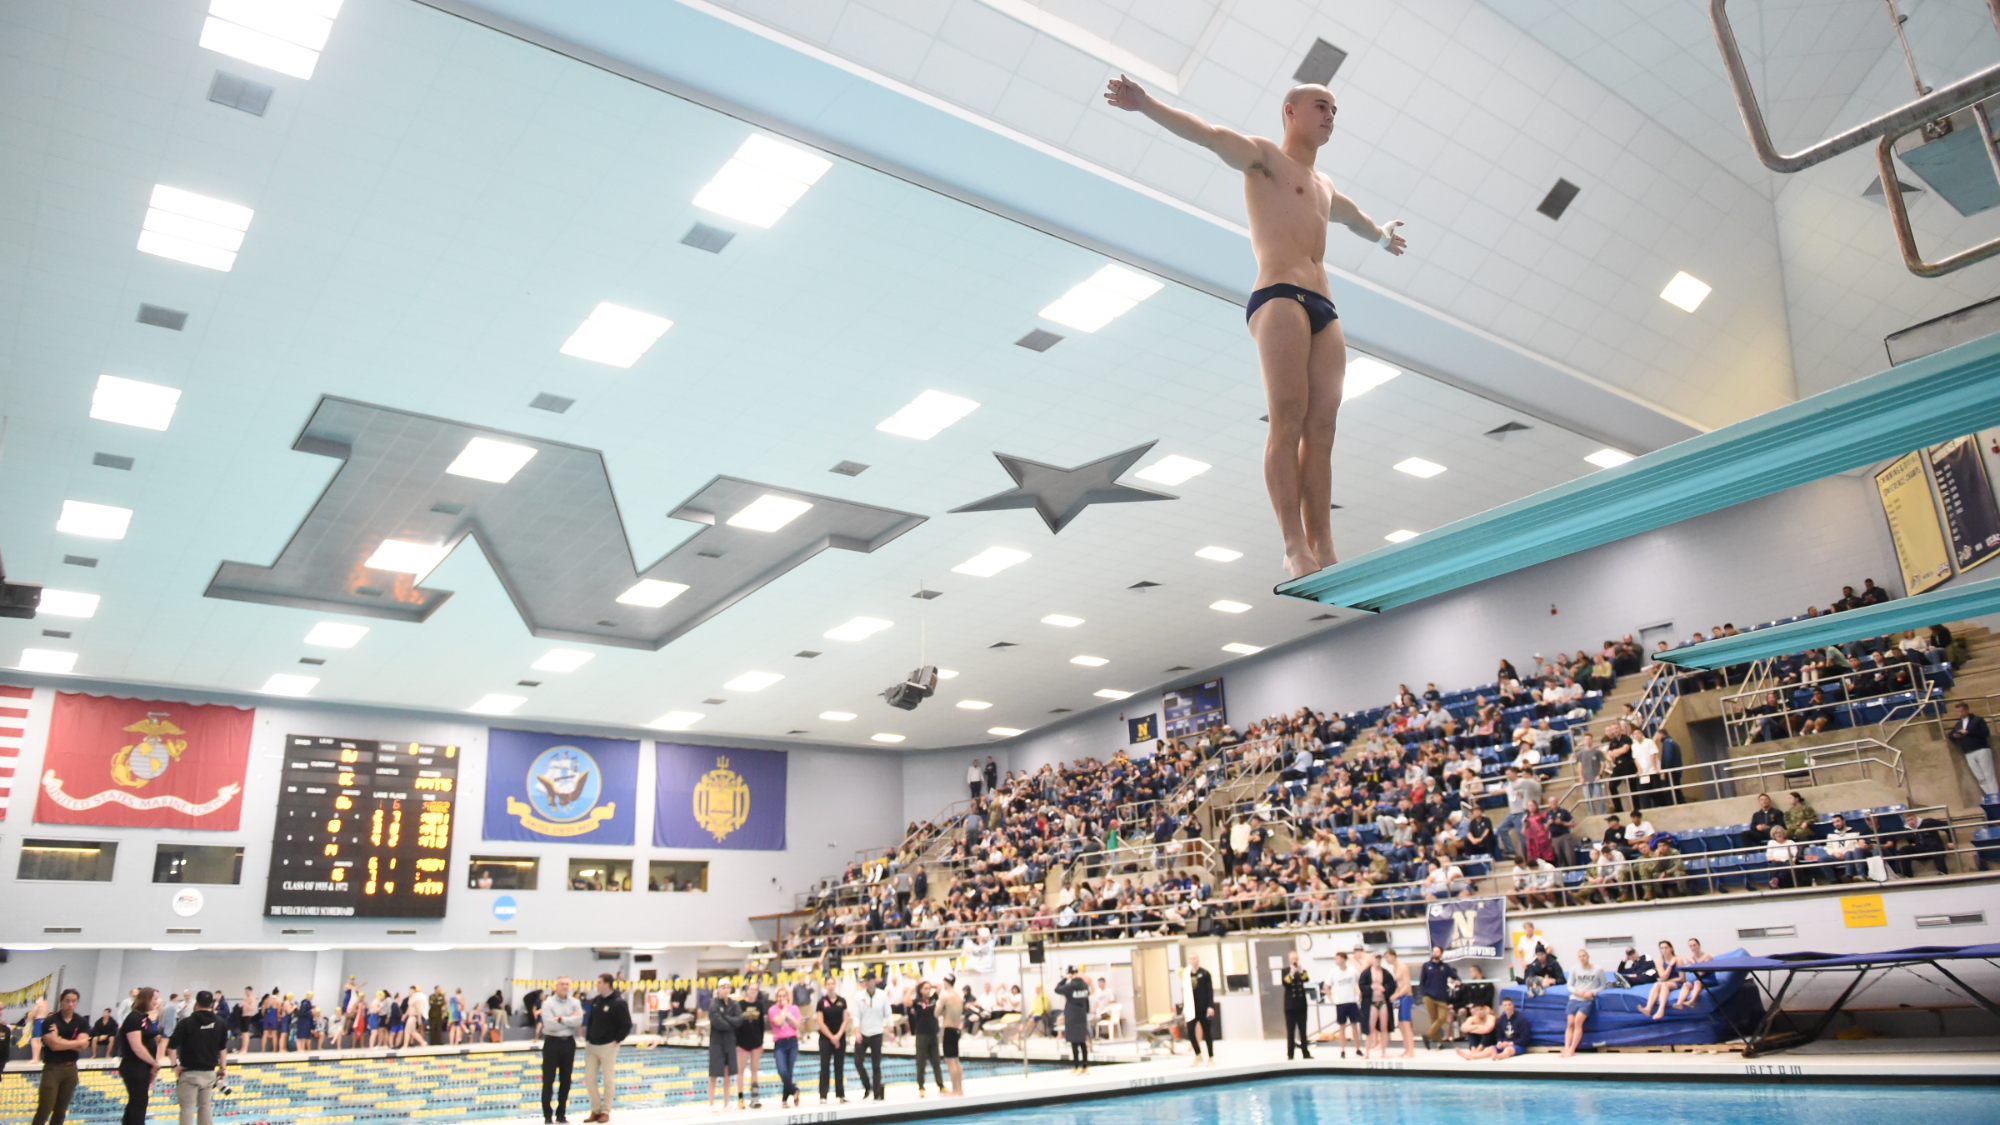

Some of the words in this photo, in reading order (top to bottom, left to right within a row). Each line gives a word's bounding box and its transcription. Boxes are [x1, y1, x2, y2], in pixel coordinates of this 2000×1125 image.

[48, 785, 90, 810] UNITED
[93, 791, 135, 807] STATES
[140, 798, 189, 812] MARINE
[282, 880, 304, 891] CLASS
[305, 881, 315, 891] OF
[270, 905, 282, 916] THE
[320, 906, 355, 917] SCOREBOARD
[1452, 910, 1477, 939] N
[1469, 945, 1496, 957] DIVING
